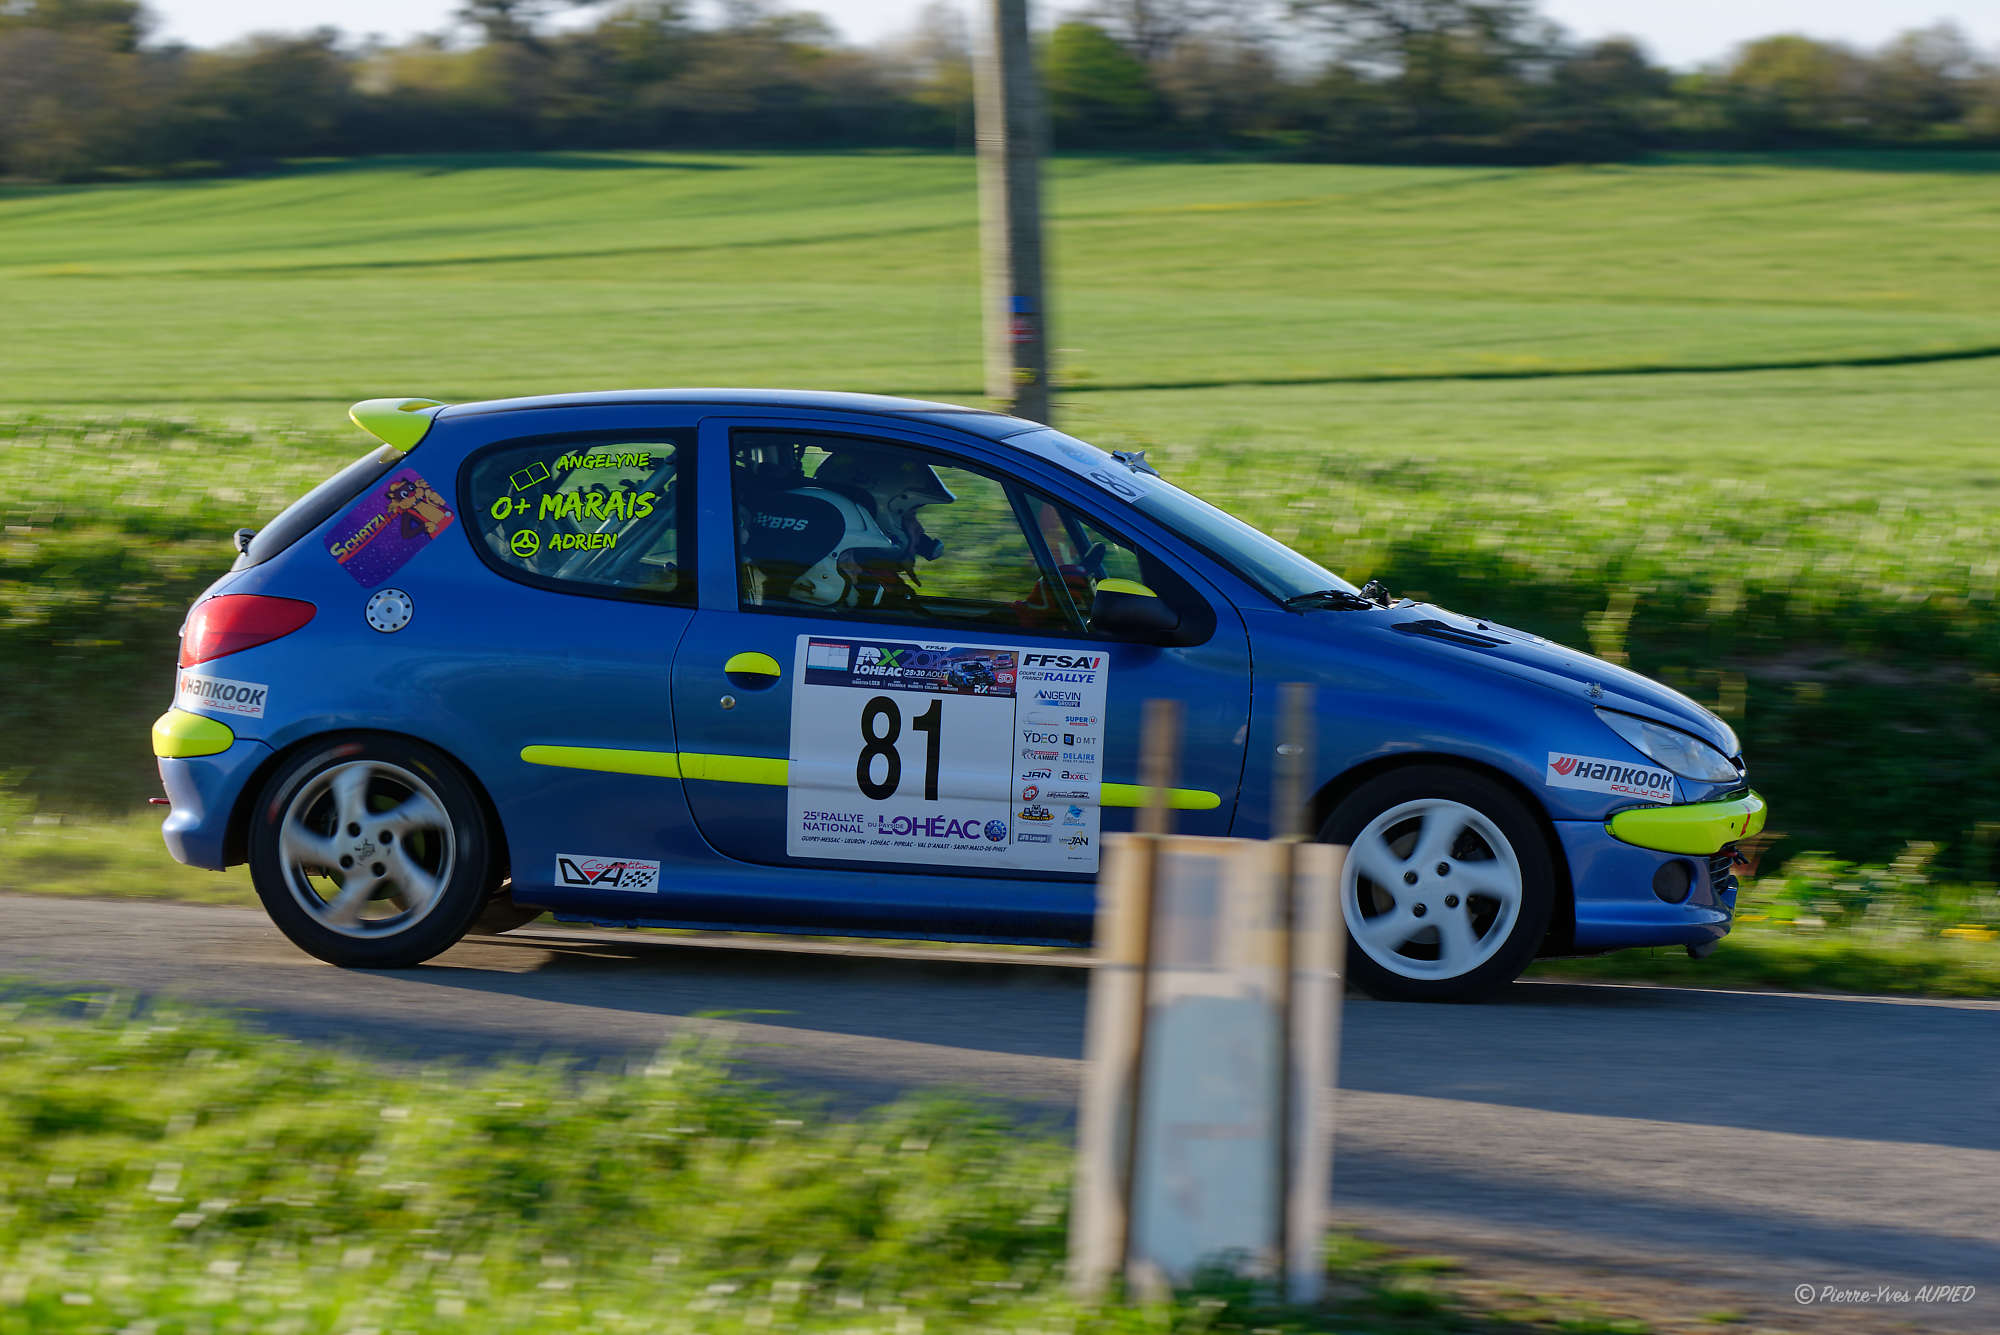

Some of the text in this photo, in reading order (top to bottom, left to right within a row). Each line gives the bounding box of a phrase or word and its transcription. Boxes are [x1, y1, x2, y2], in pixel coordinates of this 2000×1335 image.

[556, 453, 650, 471] ANGELYNE
[538, 491, 656, 522] MARAIS
[548, 533, 618, 551] ADRIEN
[856, 647, 904, 667] RX
[1023, 654, 1091, 669] FFSA
[853, 665, 903, 677] LOHEAC
[1044, 672, 1095, 683] RALLYE
[1034, 689, 1080, 701] ANGEVIN
[857, 696, 943, 801] 81
[1063, 753, 1095, 761] DELAIRE
[1650, 791, 1671, 799] CUP
[821, 812, 864, 823] RALLYE
[803, 822, 864, 834] NATIONAL
[878, 815, 981, 839] LOHÉAC
